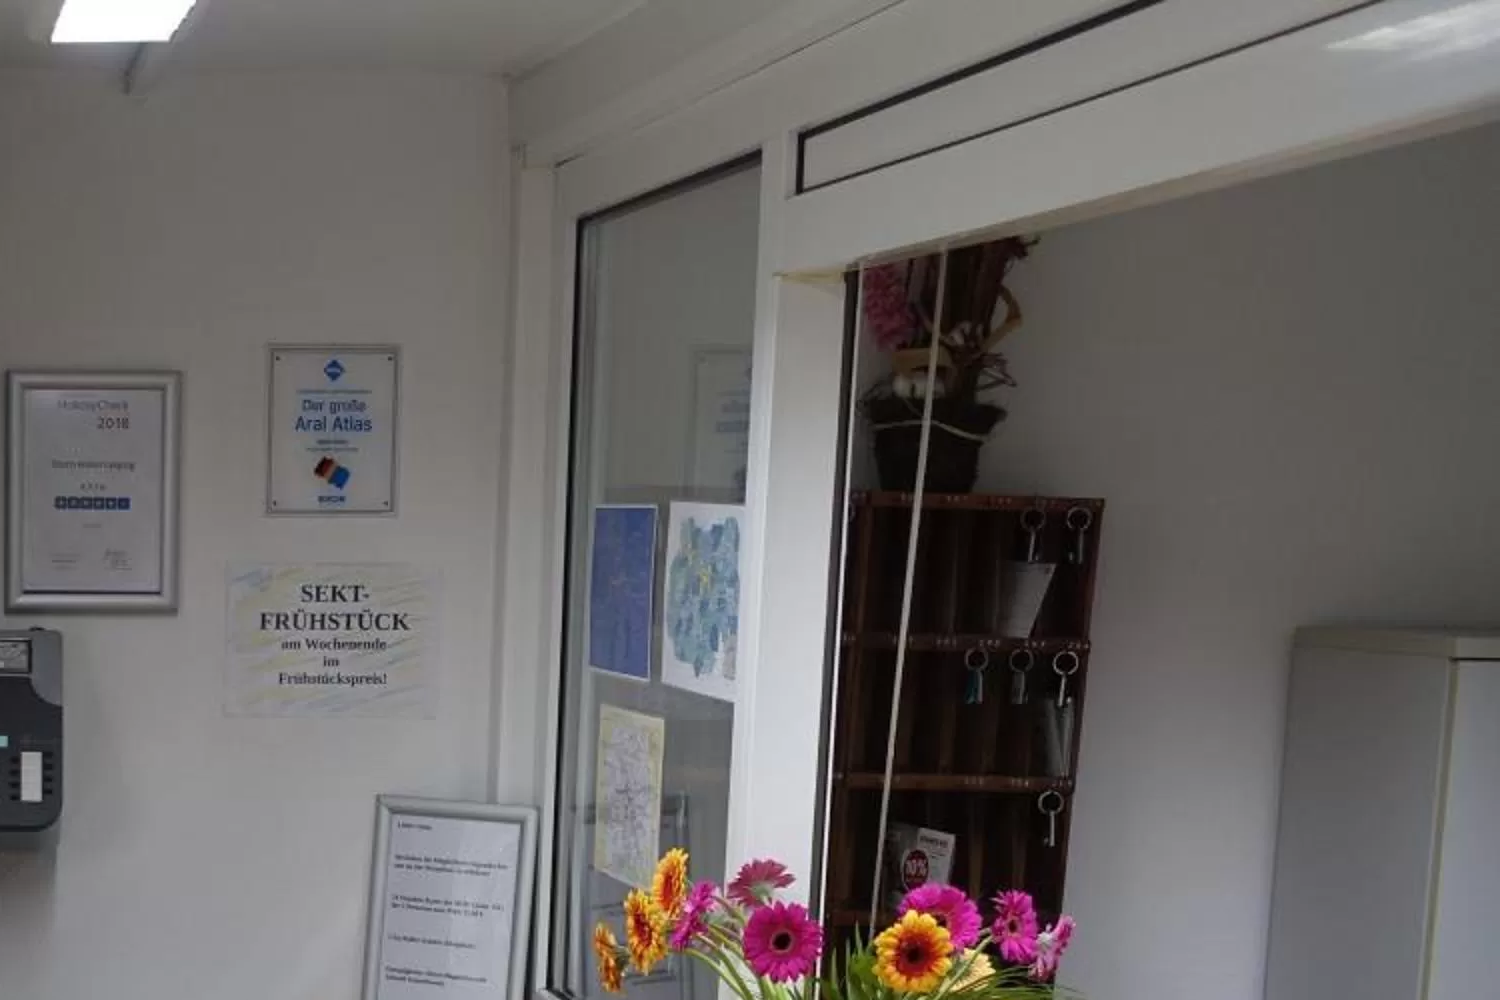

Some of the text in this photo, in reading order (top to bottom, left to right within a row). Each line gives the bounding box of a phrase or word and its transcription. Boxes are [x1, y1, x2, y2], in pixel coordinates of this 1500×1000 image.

[302, 399, 325, 412] Der
[295, 415, 373, 432] Aral Atlas
[301, 584, 370, 603] SEKT-
[260, 609, 411, 631] FRÜHSTÜCK
[281, 637, 387, 650] am Wochenende
[323, 655, 340, 667] im
[278, 671, 387, 686] Frühstückspreis!
